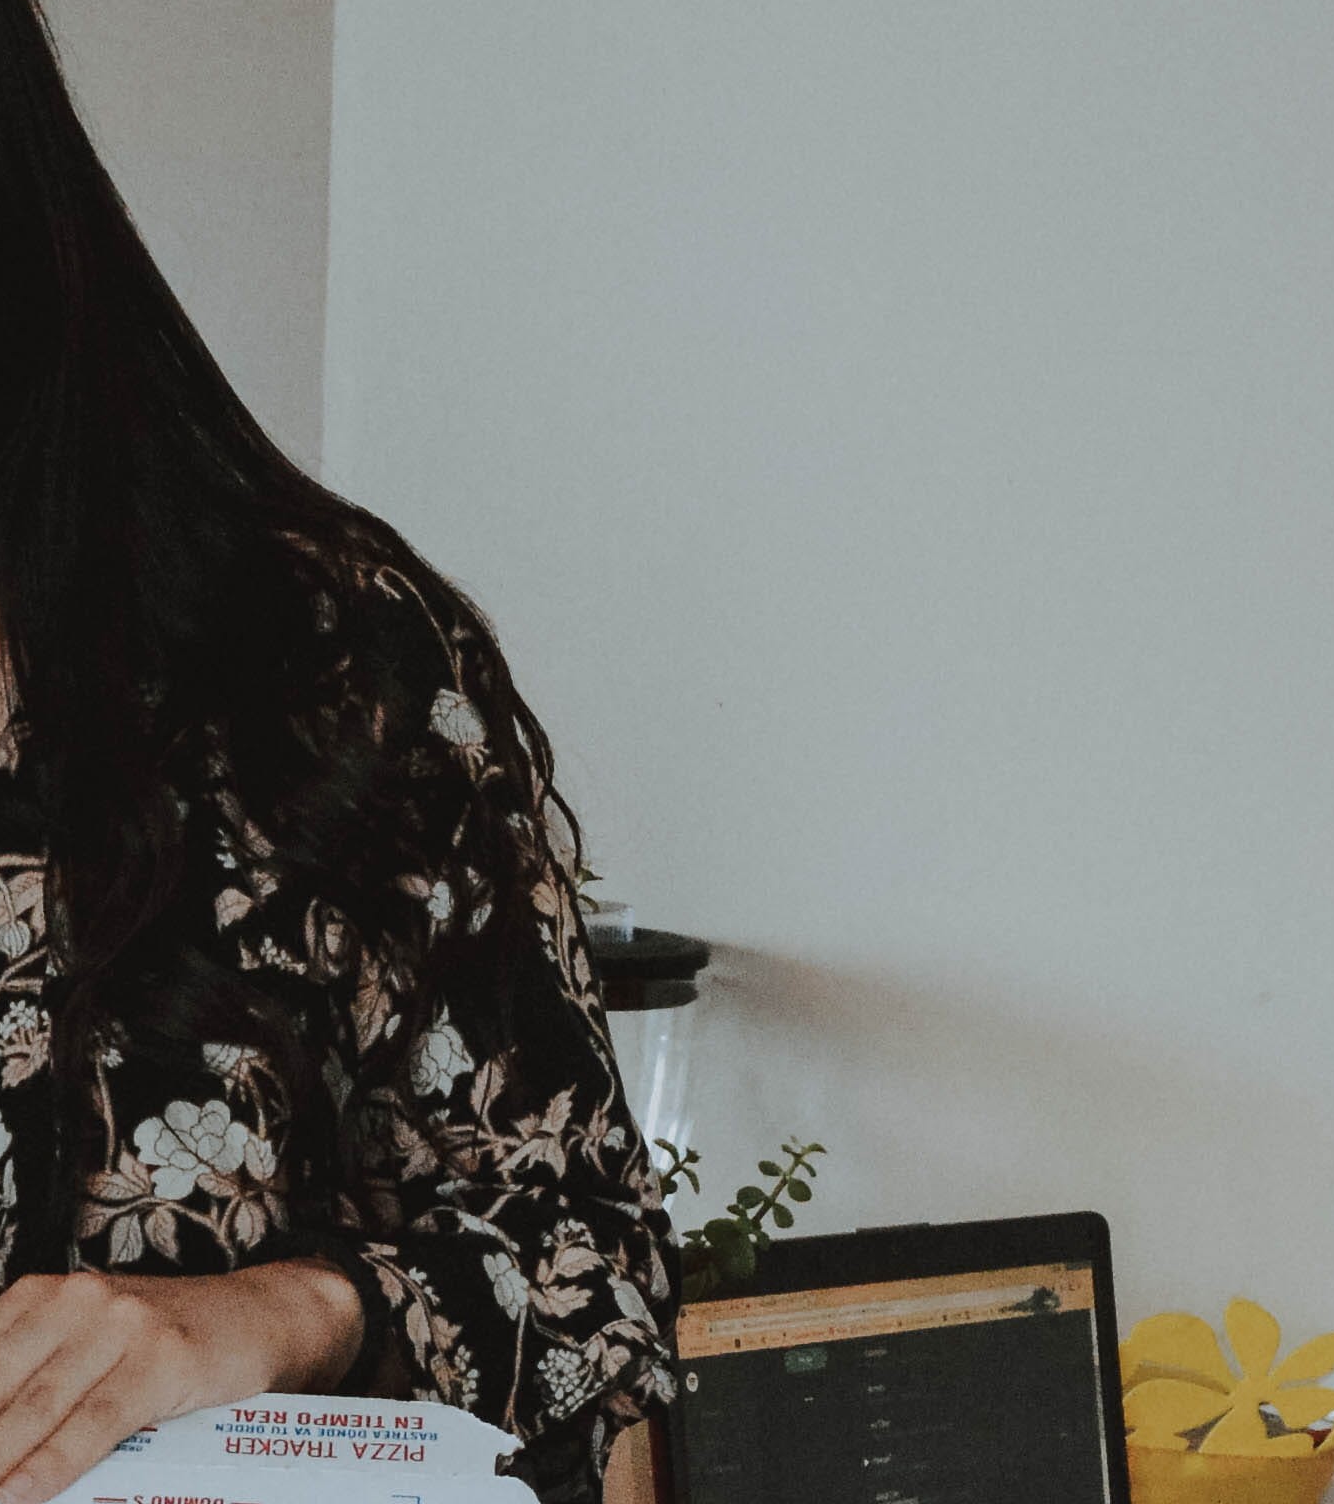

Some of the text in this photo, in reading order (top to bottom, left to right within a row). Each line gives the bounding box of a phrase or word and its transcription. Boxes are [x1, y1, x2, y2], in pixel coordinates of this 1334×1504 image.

[231, 1409, 423, 1429] EN TIEMPO REAL
[226, 1436, 424, 1462] PIZZA TRACKER
